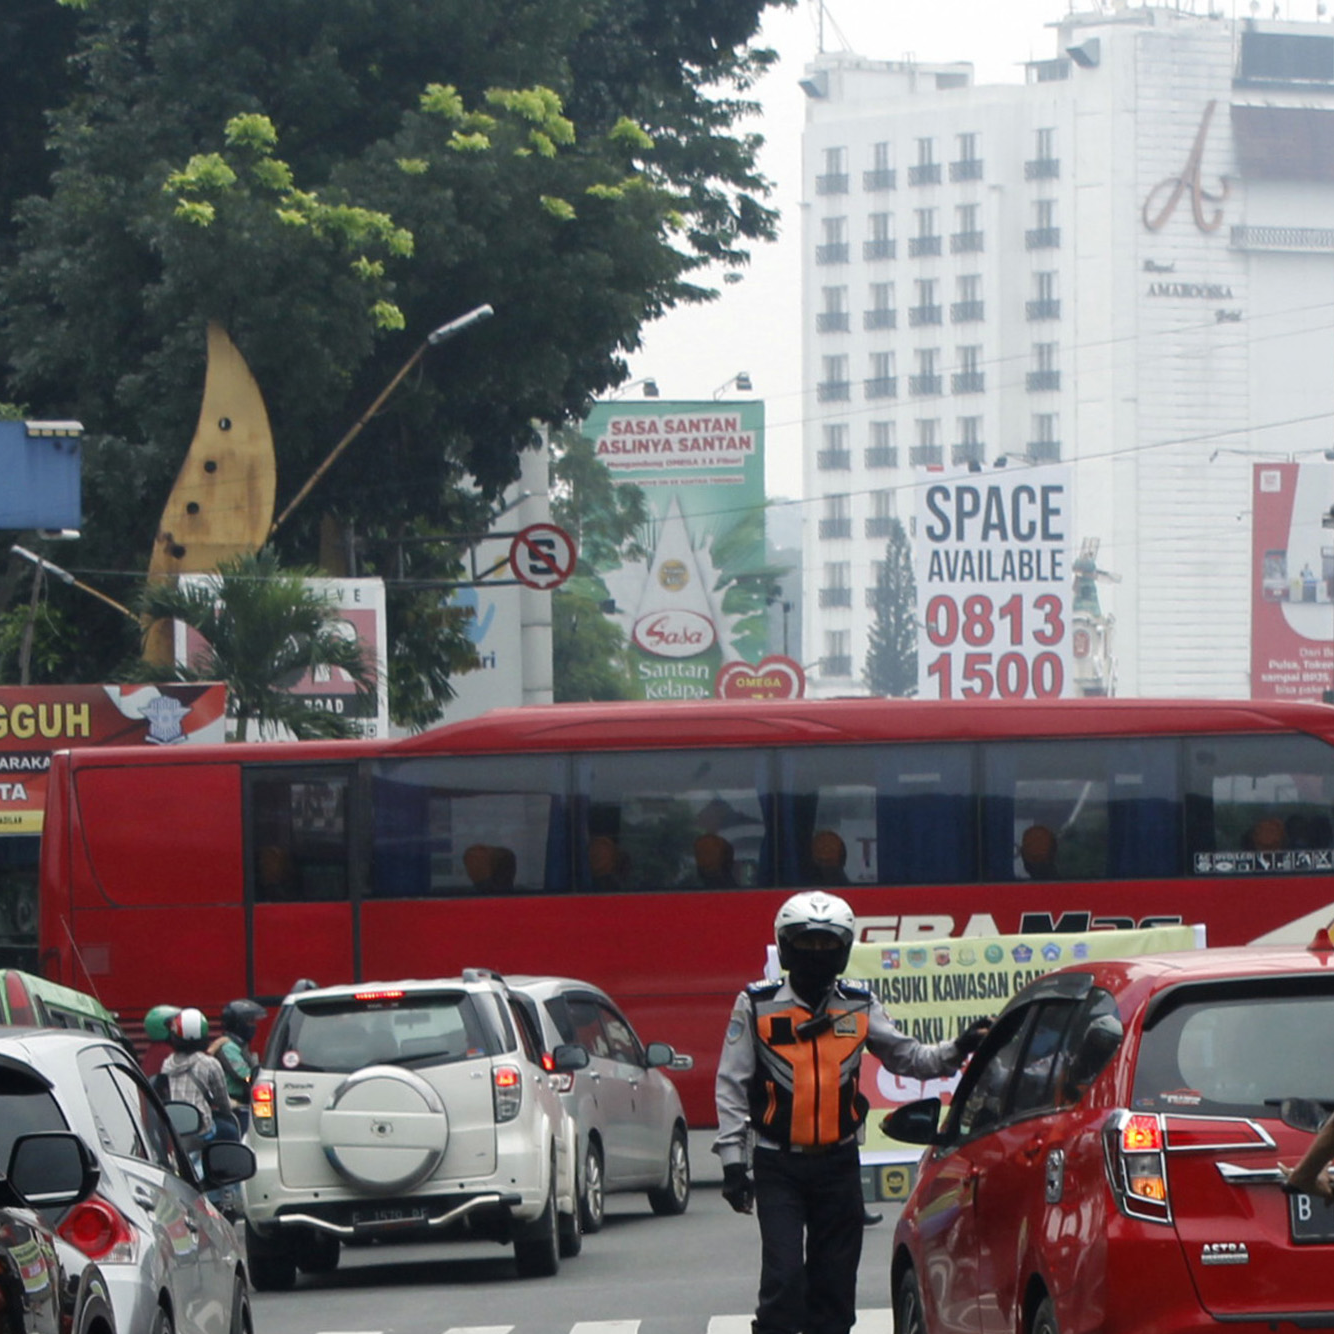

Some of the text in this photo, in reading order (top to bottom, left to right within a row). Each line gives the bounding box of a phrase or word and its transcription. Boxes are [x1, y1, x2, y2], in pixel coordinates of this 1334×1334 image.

[611, 417, 737, 436] SASA SANTAN
[597, 435, 751, 455] ASLINYA SANTAN
[925, 485, 1064, 543] SPACE
[928, 549, 1064, 583] AVAILABLE
[646, 615, 703, 647] Sasa
[925, 593, 1065, 648] 0813
[638, 661, 710, 679] Santan
[736, 677, 781, 688] OMEGA
[927, 651, 1064, 700] 1500
[868, 971, 1009, 1005] MASUKI KAWASAN
[1297, 1194, 1312, 1221] B
[1203, 1242, 1247, 1254] ASTRA
